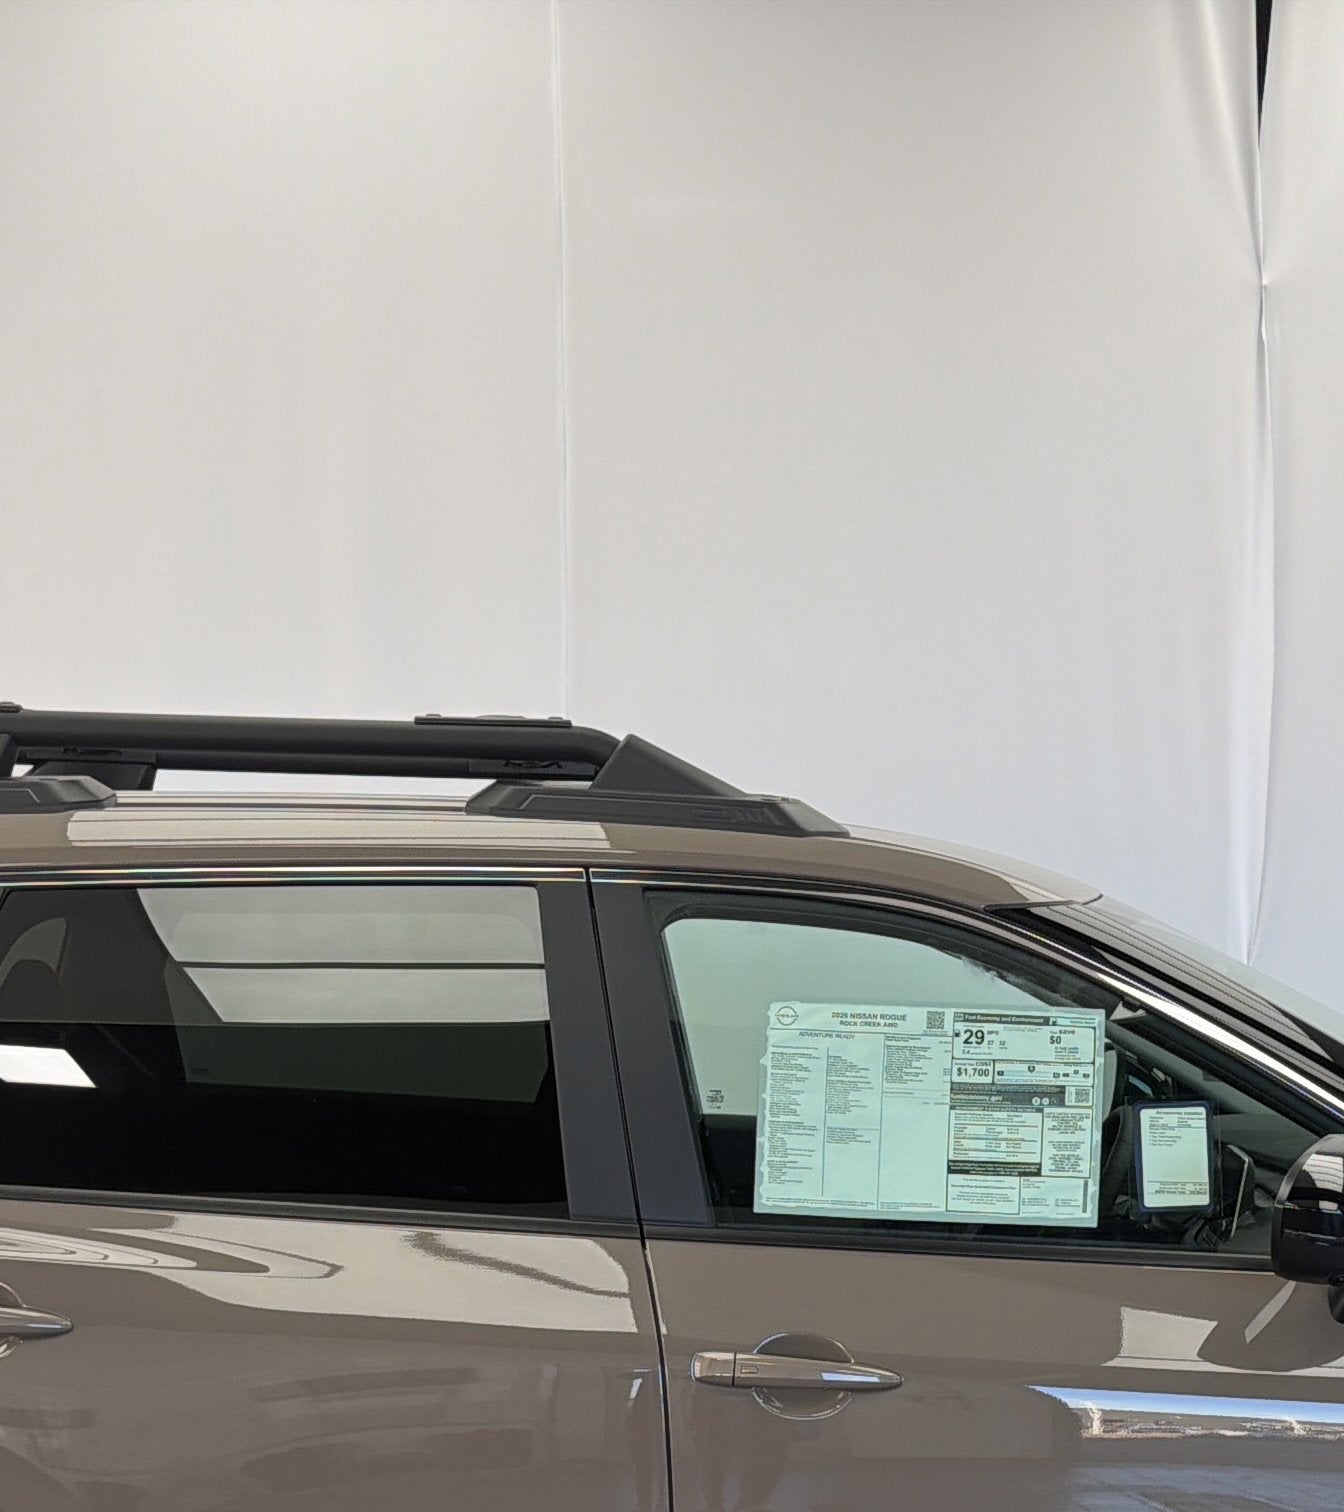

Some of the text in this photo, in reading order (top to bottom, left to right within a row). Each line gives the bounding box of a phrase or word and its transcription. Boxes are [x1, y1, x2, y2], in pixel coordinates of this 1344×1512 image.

[879, 1013, 907, 1021] ROGUE
[798, 1031, 833, 1039] ADVENTURE
[963, 1029, 985, 1045] 29
[1049, 1035, 1062, 1045] $0
[956, 1067, 990, 1078] $1,700
